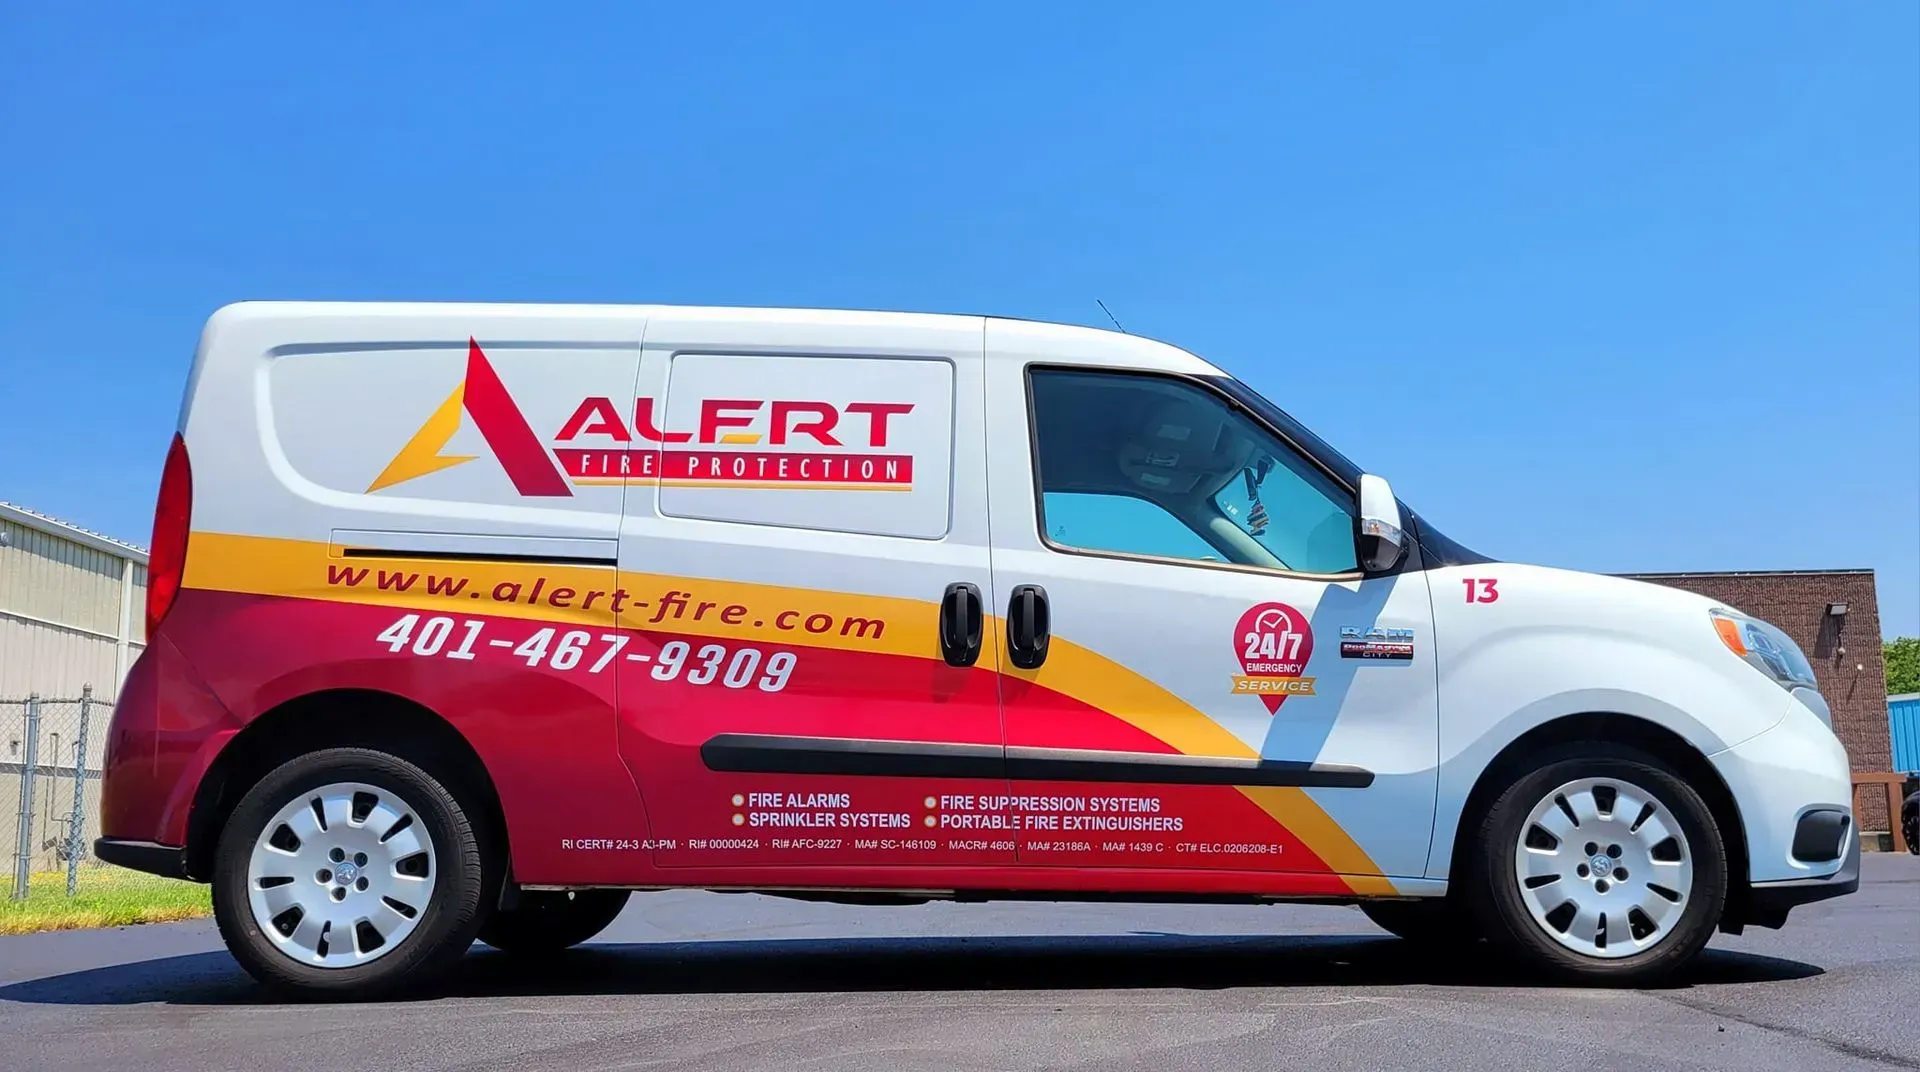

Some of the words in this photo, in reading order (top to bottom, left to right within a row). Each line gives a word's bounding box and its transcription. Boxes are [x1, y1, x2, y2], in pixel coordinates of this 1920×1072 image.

[554, 397, 915, 447] ALERT
[581, 454, 653, 475] FIRE
[688, 457, 897, 479] PROTECTION
[1463, 579, 1499, 603] 13
[327, 565, 885, 640] www.alert-fire.com
[1340, 626, 1415, 642] RAM
[376, 614, 798, 693] 401-467-9309
[1244, 632, 1303, 660] 24/7
[1246, 663, 1302, 673] EMERGENCY
[1237, 680, 1310, 691] SERVICE
[749, 793, 783, 807] FIRE
[786, 794, 850, 808] ALARMS
[940, 795, 974, 809] FIRE
[978, 796, 1085, 811] SUPPRESSION
[1089, 797, 1160, 812] SYSTEMS
[749, 812, 836, 827] SPRINKLER
[839, 813, 911, 828] SYSTEMS
[940, 814, 1021, 829] PORTABLE
[1025, 815, 1059, 829] FIRE
[1063, 816, 1183, 831] EXTINGUISHERS
[562, 839, 574, 849] RI
[576, 839, 614, 849] CERT#
[616, 840, 639, 850] 24-3
[689, 839, 707, 849] RI#
[709, 839, 759, 849] 00000424
[772, 839, 790, 849] RI#
[791, 839, 842, 849] AFC-9227
[855, 839, 878, 849] MA#
[880, 839, 937, 850] SC-146109
[948, 840, 987, 850] MACR#
[989, 840, 1016, 850] 4606
[1027, 841, 1051, 851] MA#
[1053, 841, 1091, 851] 23186A
[1102, 842, 1126, 852] MA#
[1128, 842, 1153, 852] 1439
[1155, 842, 1164, 852] C
[1175, 843, 1198, 853] CT#
[1199, 843, 1284, 854] ELC.0206208-E1
